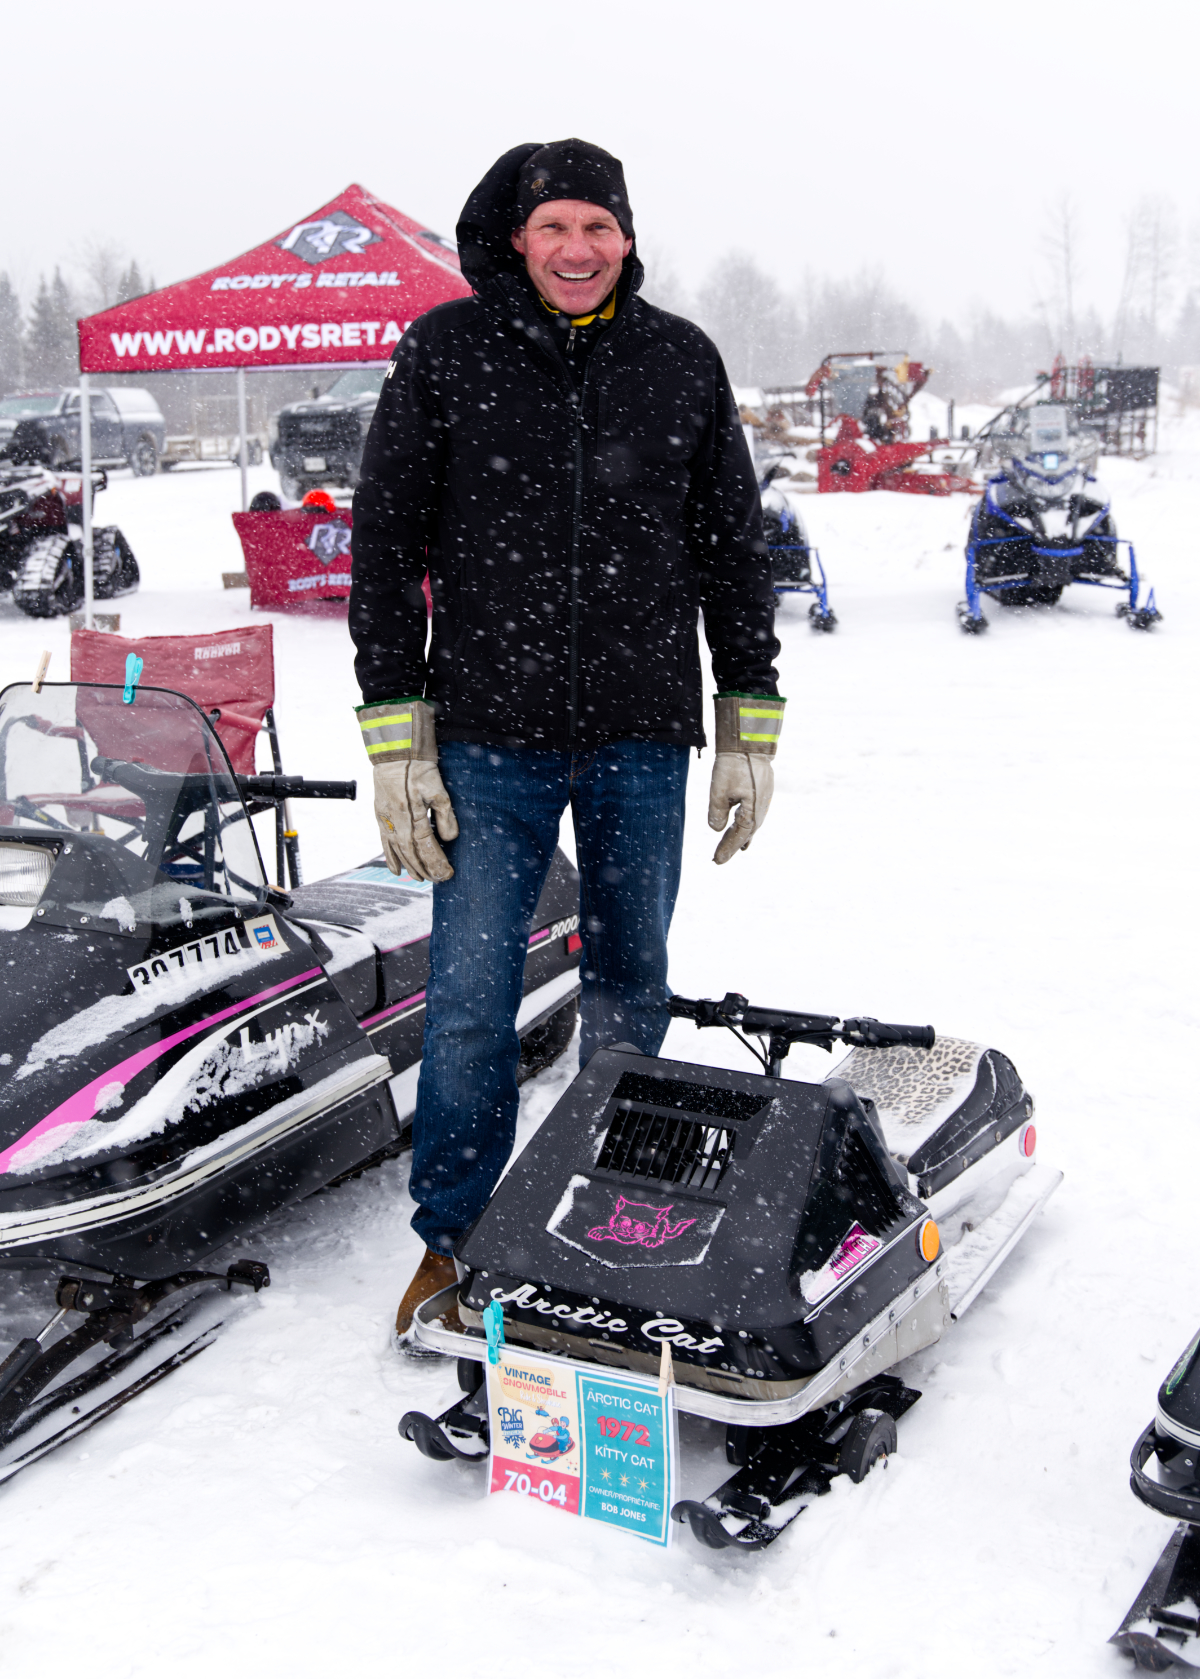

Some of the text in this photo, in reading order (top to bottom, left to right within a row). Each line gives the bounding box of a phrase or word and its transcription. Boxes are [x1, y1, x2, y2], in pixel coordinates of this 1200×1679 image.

[211, 271, 401, 290] RODY'S RETAIL
[550, 914, 580, 941] 2000
[239, 1008, 328, 1065] Lynx
[490, 1283, 725, 1355] Arctic Cat
[503, 1377, 567, 1399] SNOWMOBILE
[504, 1366, 551, 1386] VINTAGE
[497, 1406, 523, 1424] BIG
[586, 1391, 659, 1416] ARCTIC CAT
[596, 1415, 651, 1448] 1972
[595, 1445, 656, 1470] KITTY CAT
[503, 1469, 567, 1506] 70-04
[601, 1502, 646, 1522] BOB JONES
